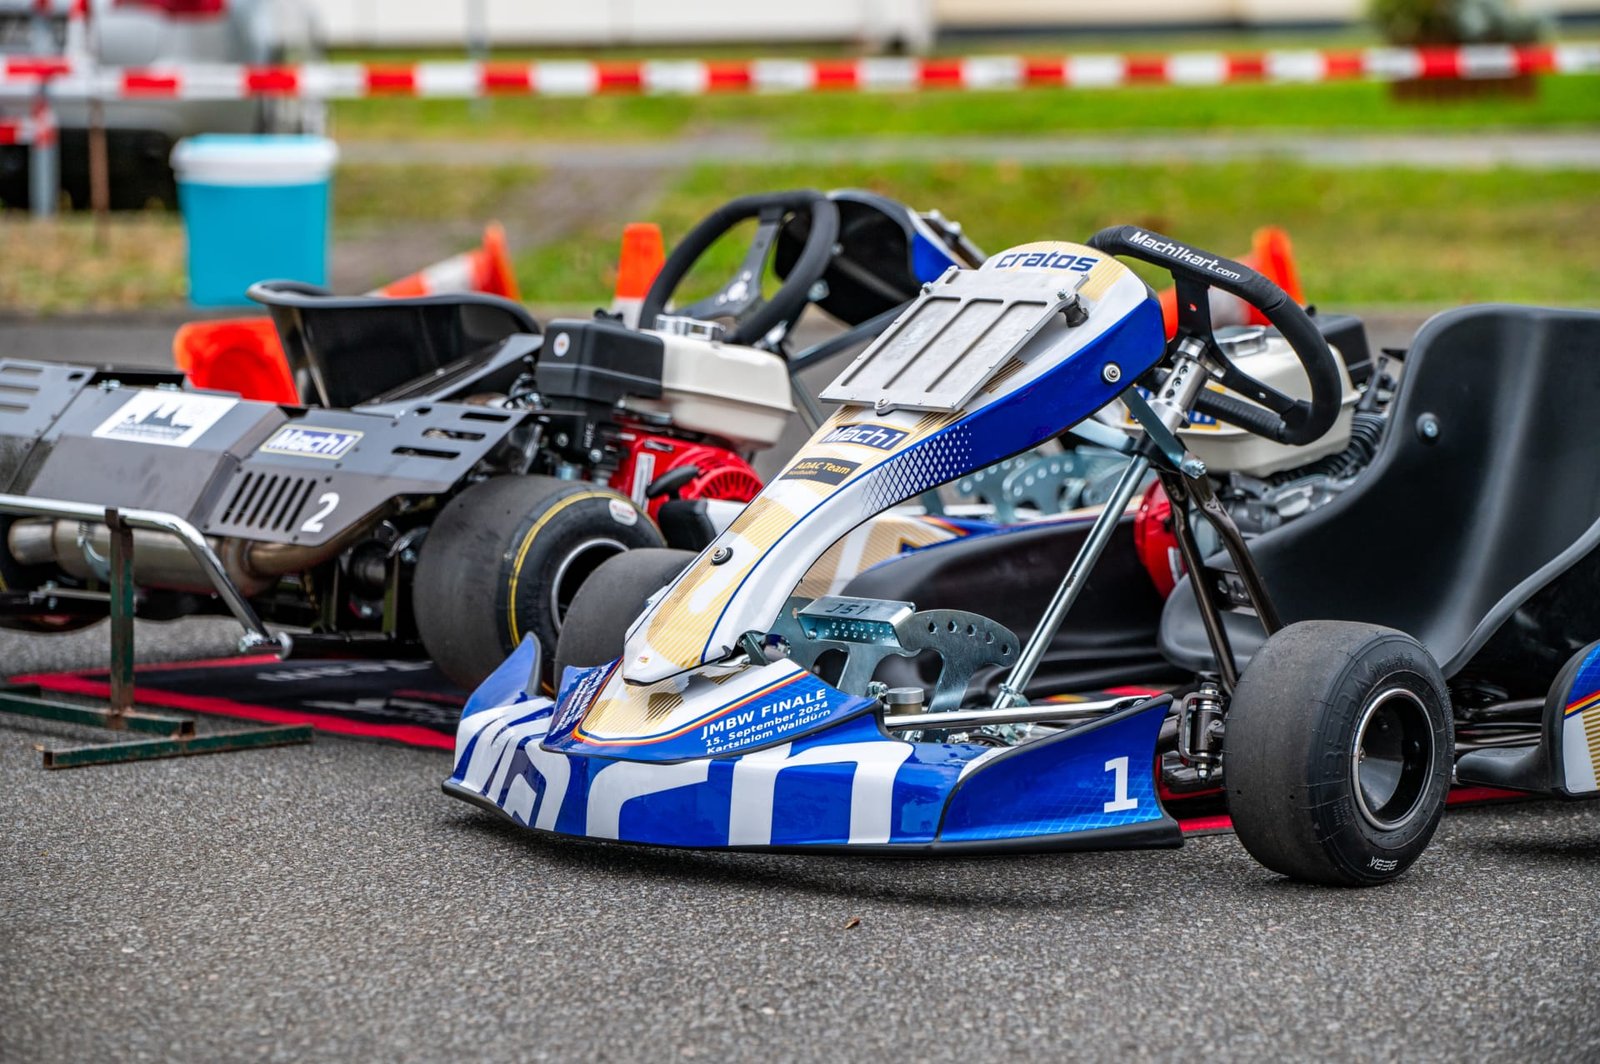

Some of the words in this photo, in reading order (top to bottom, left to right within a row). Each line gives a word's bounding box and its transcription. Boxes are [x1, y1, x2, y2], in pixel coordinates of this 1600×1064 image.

[995, 250, 1099, 272] cratos
[1128, 231, 1241, 281] Mach1kart.com
[823, 428, 905, 449] Mach1
[823, 462, 850, 475] Team
[301, 492, 340, 533] 2
[701, 711, 755, 740] JMBW
[761, 689, 826, 718] FINALE
[706, 737, 724, 747] 15.
[728, 712, 795, 740] September
[798, 701, 829, 717] 2024
[706, 731, 773, 754] Kartslalom
[777, 709, 831, 733] Walldürn
[1104, 756, 1138, 813] 1
